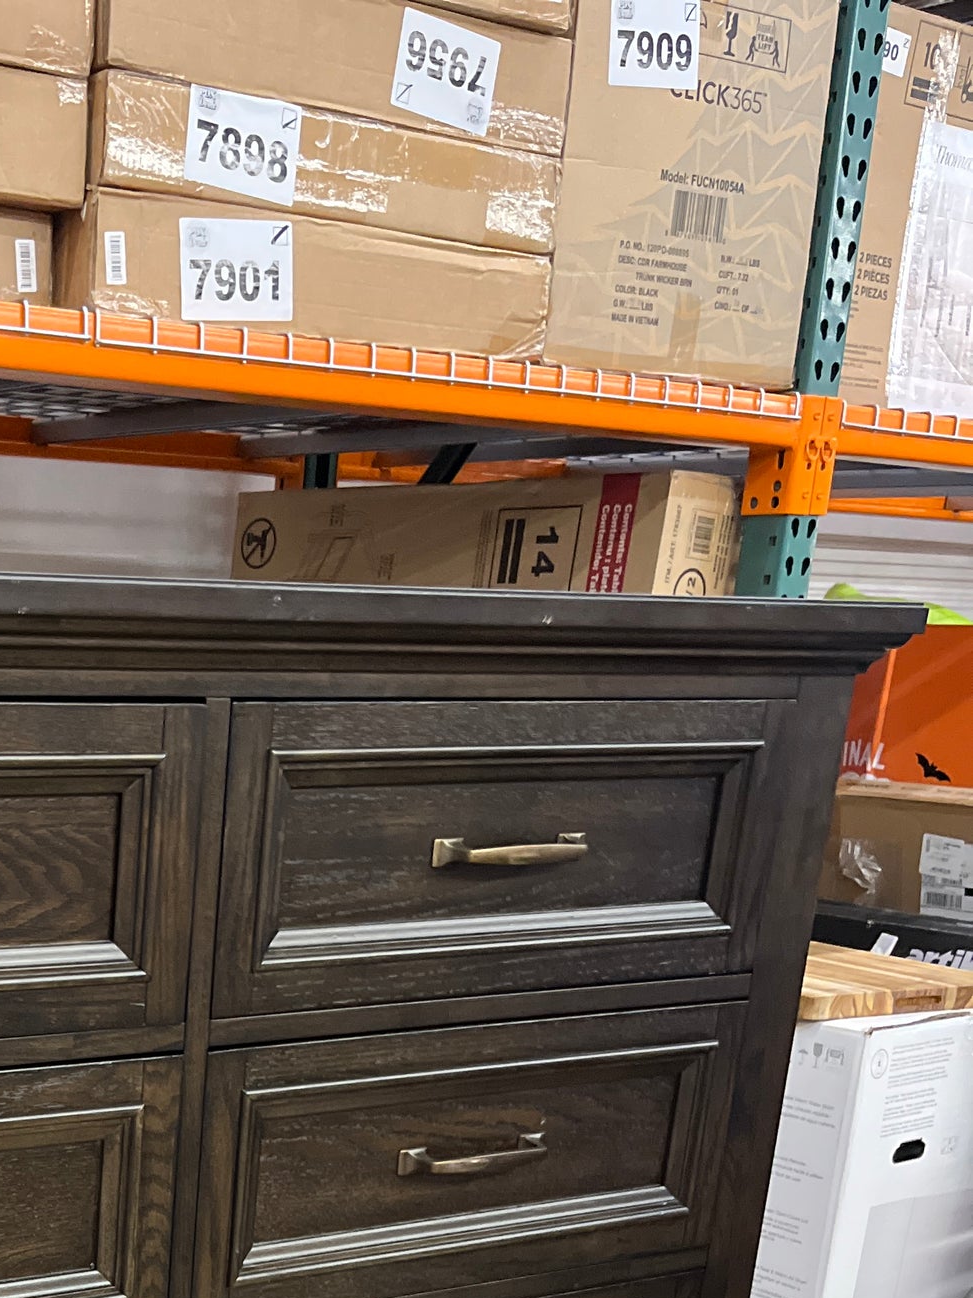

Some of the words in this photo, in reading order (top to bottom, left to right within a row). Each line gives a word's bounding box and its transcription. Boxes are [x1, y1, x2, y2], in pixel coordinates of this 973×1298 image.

[406, 30, 487, 97] 7956
[617, 29, 692, 71] 7909
[670, 80, 763, 114] ICK365
[196, 118, 289, 184] 7898
[660, 169, 689, 185] Model:
[691, 174, 745, 195] FUCN10054A
[189, 259, 280, 301] 7901
[865, 254, 893, 269] PIECES
[638, 287, 659, 298] BLACK
[860, 287, 889, 301] PIEZAS
[531, 526, 559, 577] 14
